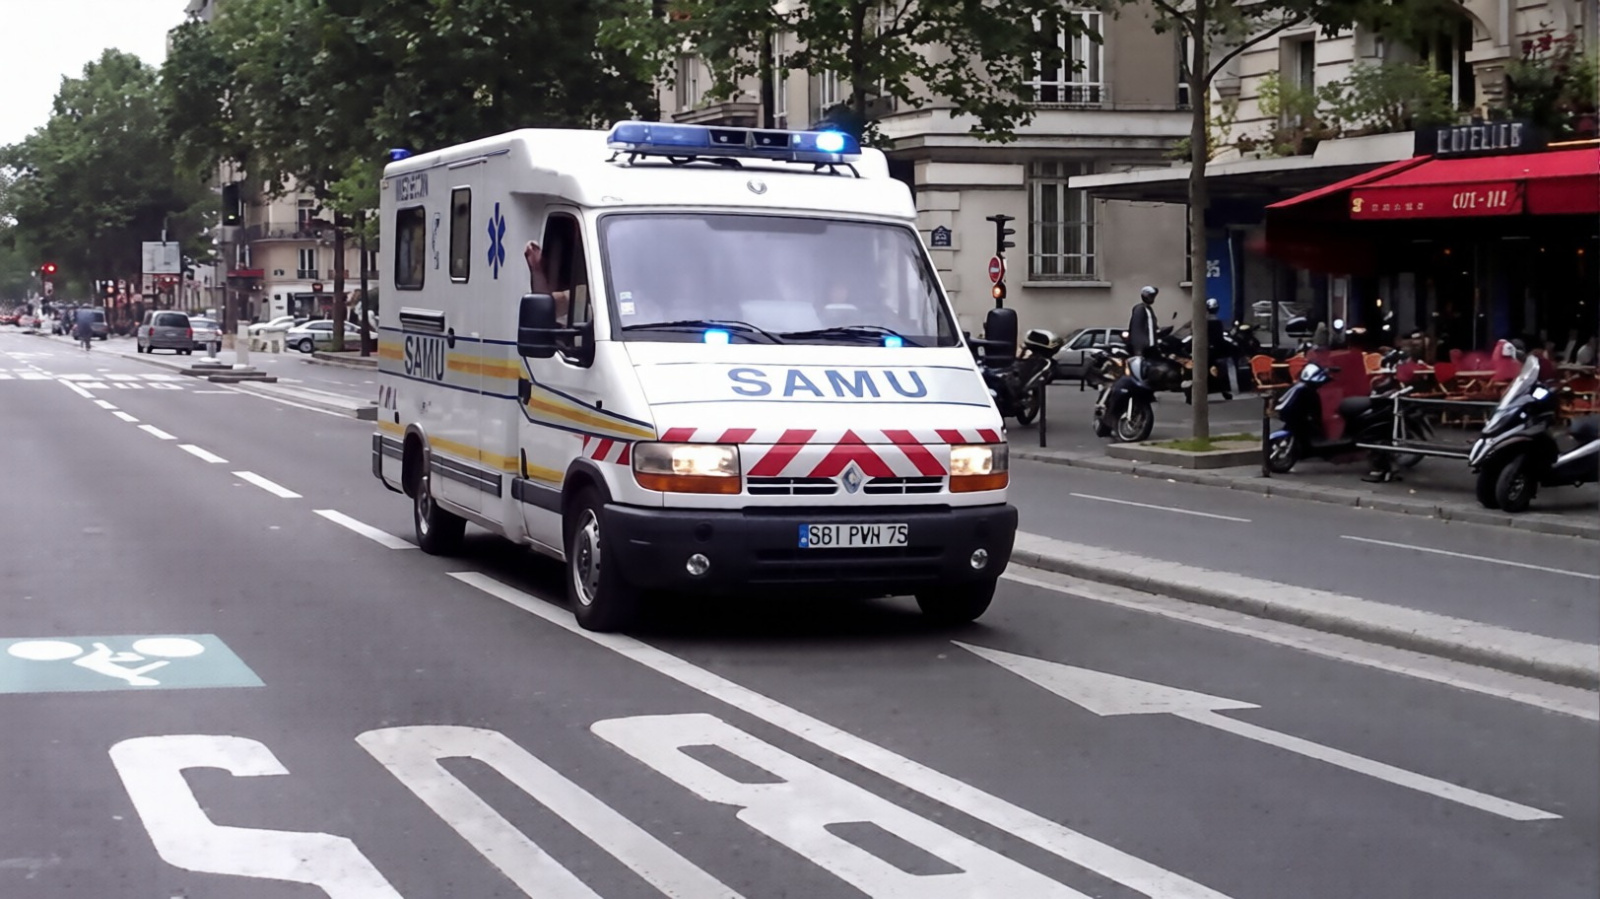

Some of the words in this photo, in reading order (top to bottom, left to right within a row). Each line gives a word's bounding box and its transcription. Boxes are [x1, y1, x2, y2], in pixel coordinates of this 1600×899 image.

[405, 335, 444, 381] SAMU
[728, 368, 928, 398] SAMU
[108, 713, 1093, 899] BUS
